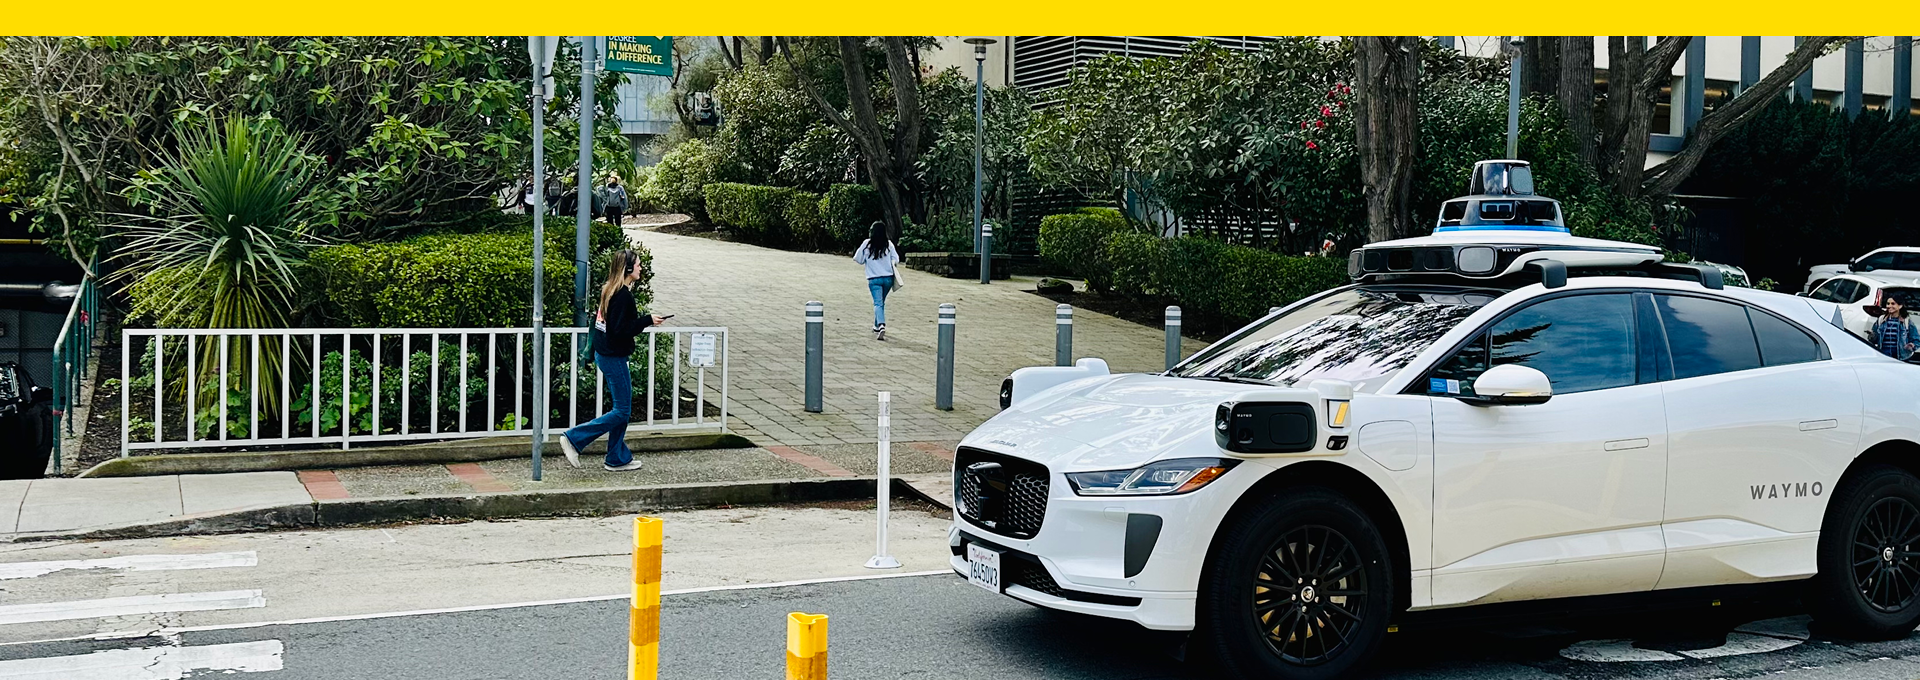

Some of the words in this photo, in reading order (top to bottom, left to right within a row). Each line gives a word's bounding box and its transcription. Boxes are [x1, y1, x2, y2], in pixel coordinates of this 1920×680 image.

[608, 41, 617, 50] IN
[619, 42, 652, 54] MAKING
[608, 50, 615, 60] A
[1750, 481, 1823, 500] WAYMO
